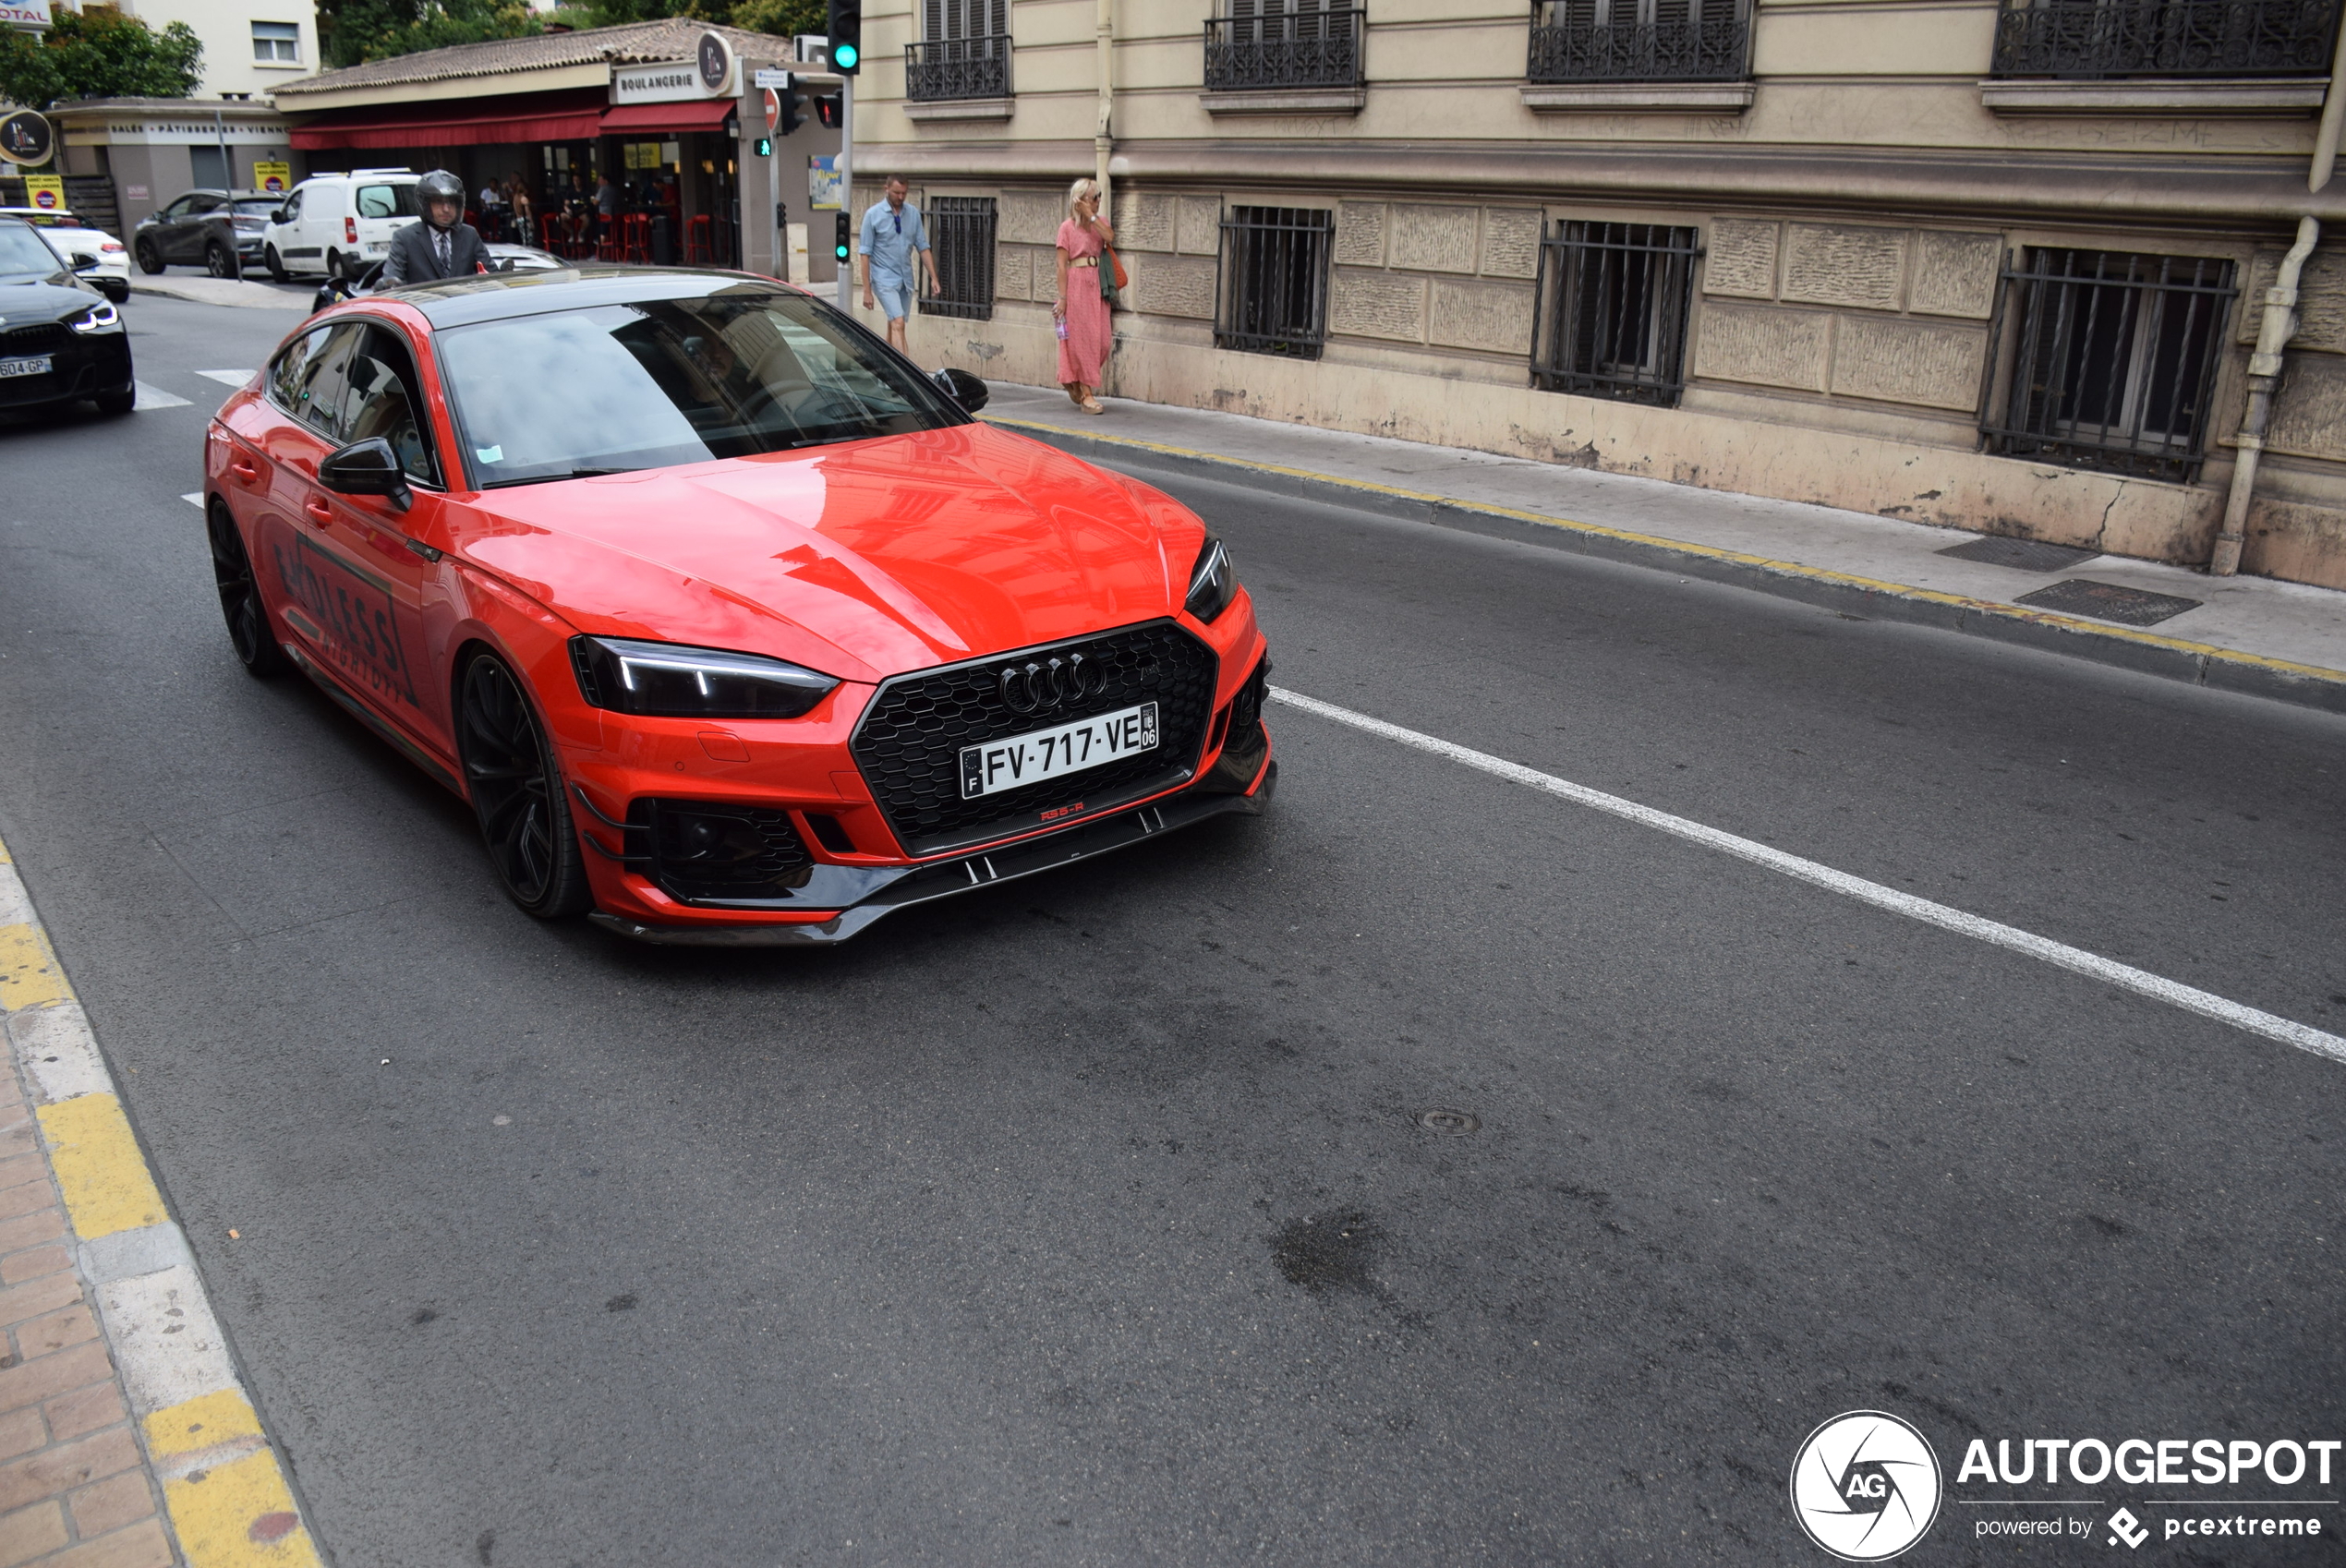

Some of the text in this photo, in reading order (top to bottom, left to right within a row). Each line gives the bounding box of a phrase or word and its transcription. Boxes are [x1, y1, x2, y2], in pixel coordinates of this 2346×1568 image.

[621, 74, 693, 91] BOULANGERIE
[158, 124, 236, 133] PÂTISSERES
[1142, 729, 1155, 746] 06
[969, 714, 1140, 791] F FV-717-VE
